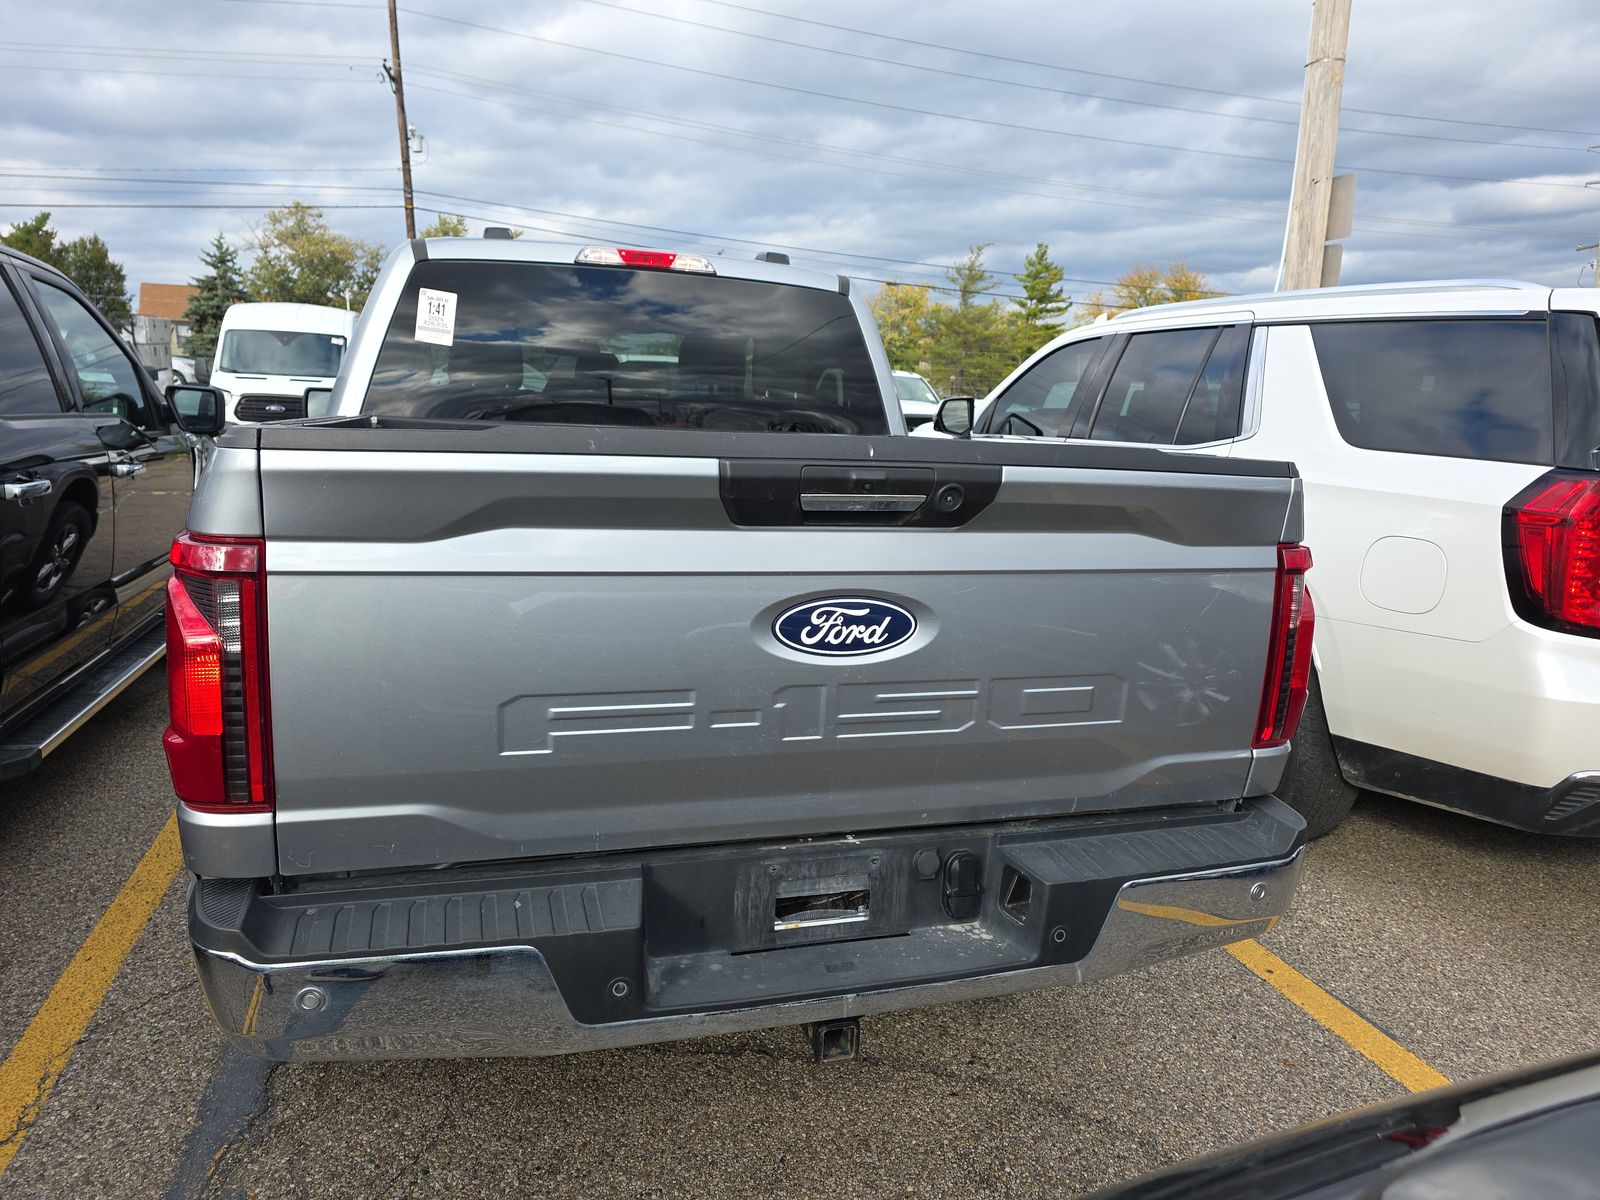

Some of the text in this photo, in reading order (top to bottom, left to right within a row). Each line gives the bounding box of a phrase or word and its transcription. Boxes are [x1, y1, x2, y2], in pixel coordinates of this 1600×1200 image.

[428, 301, 446, 316] 1:41
[800, 606, 890, 645] Ford
[498, 674, 1126, 756] F-150
